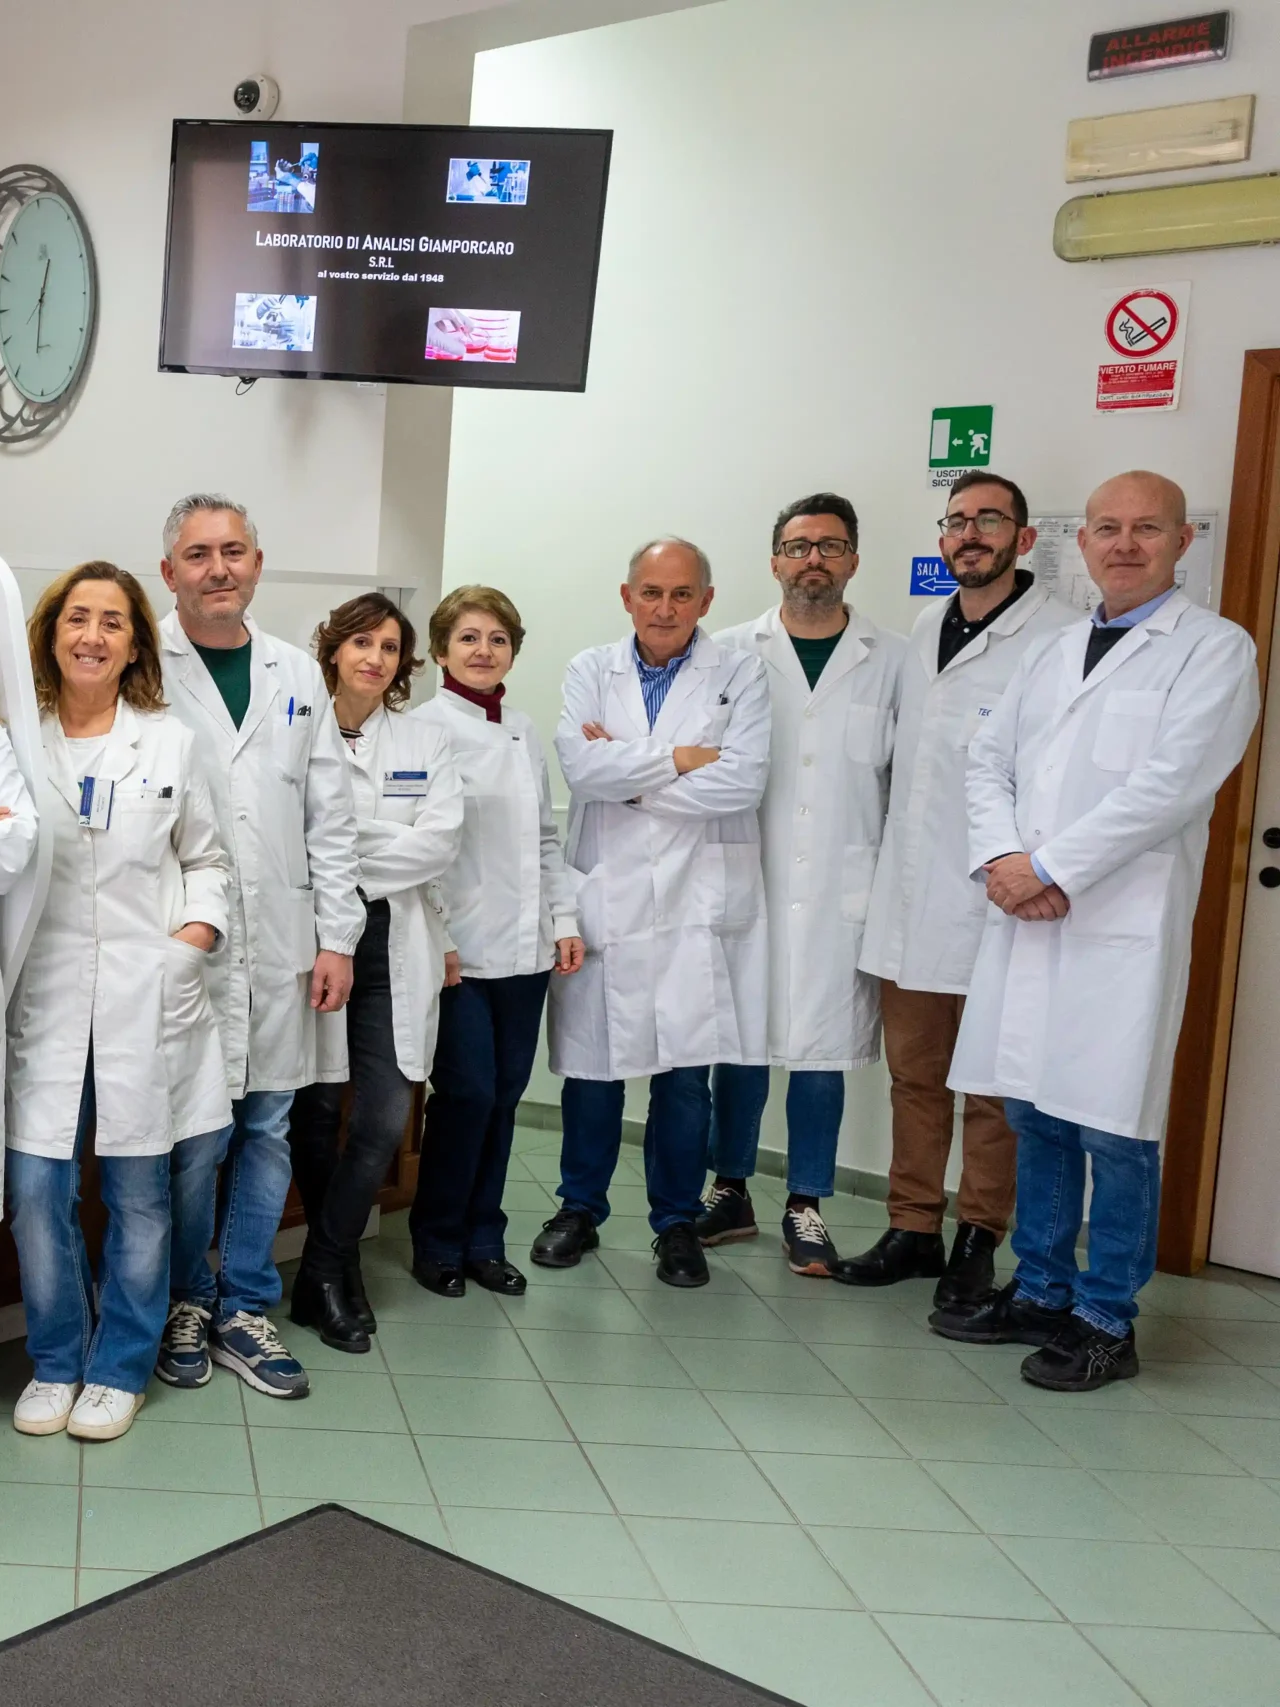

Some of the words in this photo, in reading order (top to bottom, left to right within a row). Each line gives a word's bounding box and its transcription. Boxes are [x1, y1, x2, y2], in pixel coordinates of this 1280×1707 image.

[1106, 20, 1212, 52] ALLARME
[255, 231, 343, 249] LABORATORIO
[347, 236, 359, 249] DI
[362, 234, 415, 252] ANALISI
[419, 236, 515, 256] GIAMPORCARO
[317, 270, 327, 278] al
[329, 271, 360, 280] vostro
[362, 272, 400, 281] servizio
[402, 273, 418, 282] dal
[420, 274, 444, 283] 1948
[1100, 364, 1136, 375] VIETATO
[1137, 361, 1175, 372] FUMARE
[932, 478, 956, 487] SICU
[917, 562, 940, 576] SALA
